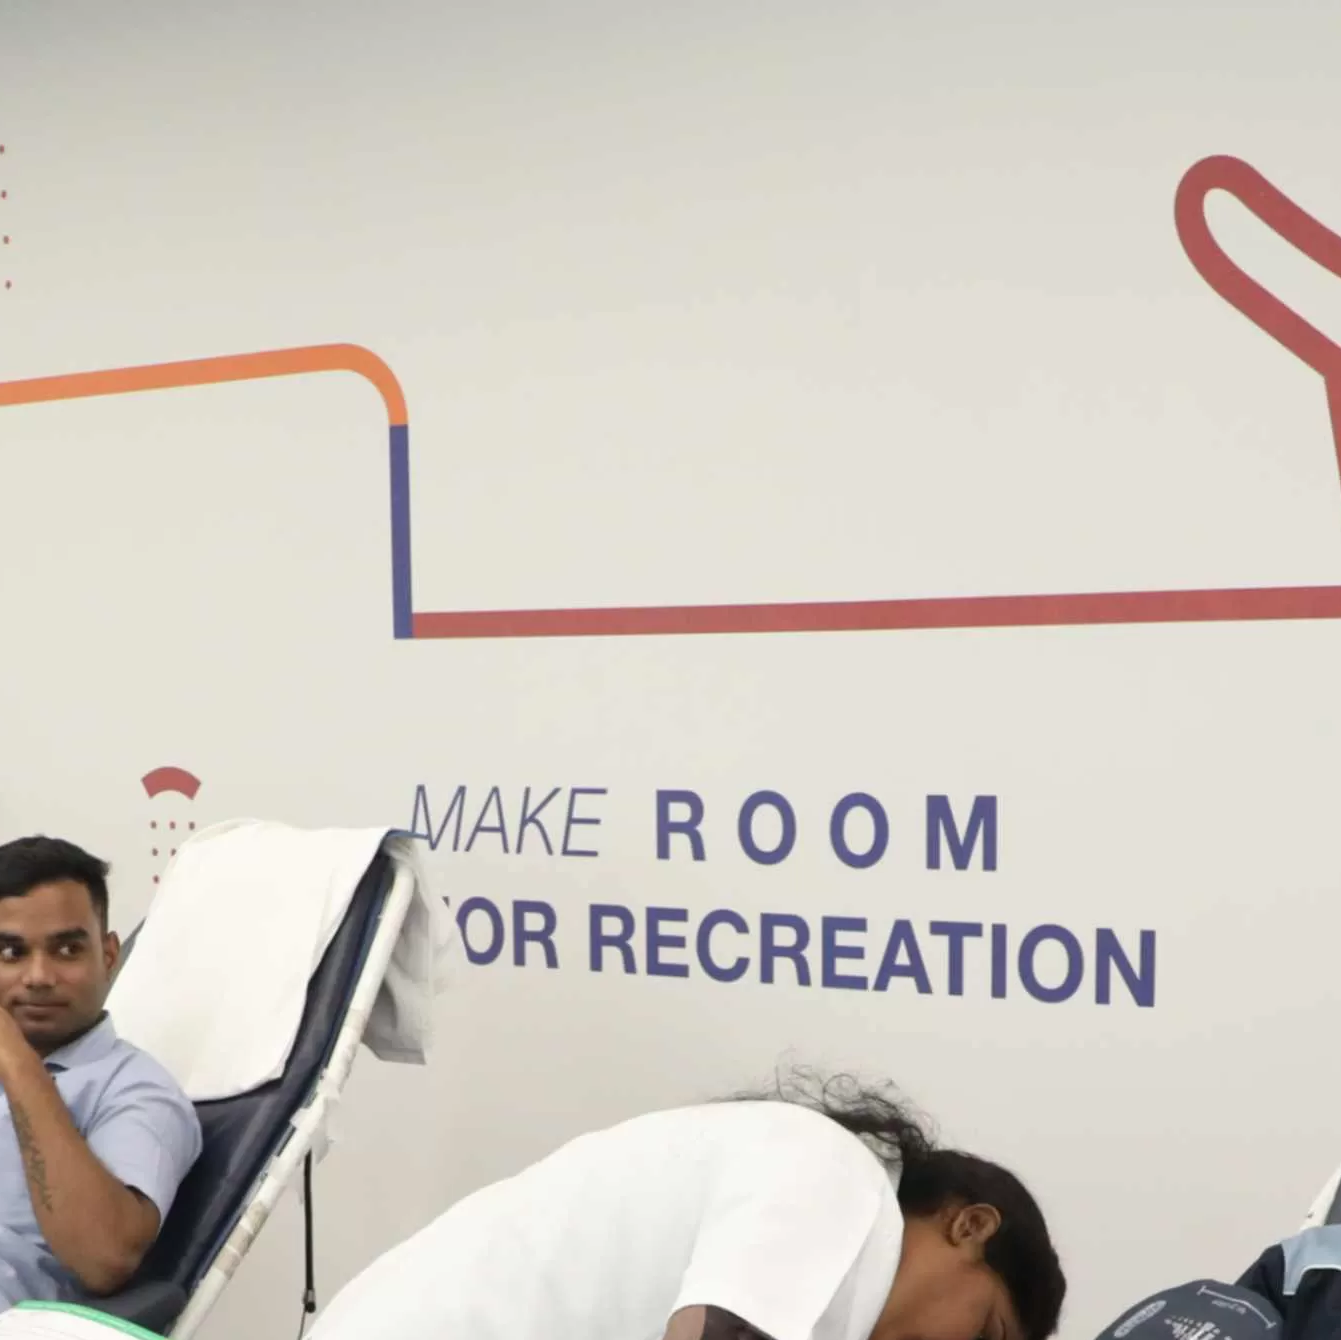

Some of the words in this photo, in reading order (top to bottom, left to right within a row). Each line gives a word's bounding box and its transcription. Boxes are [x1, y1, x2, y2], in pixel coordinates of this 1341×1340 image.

[412, 784, 608, 858] MAKE
[655, 788, 998, 873] ROOM
[442, 895, 560, 970] OR
[589, 902, 1156, 1008] RECREATION
